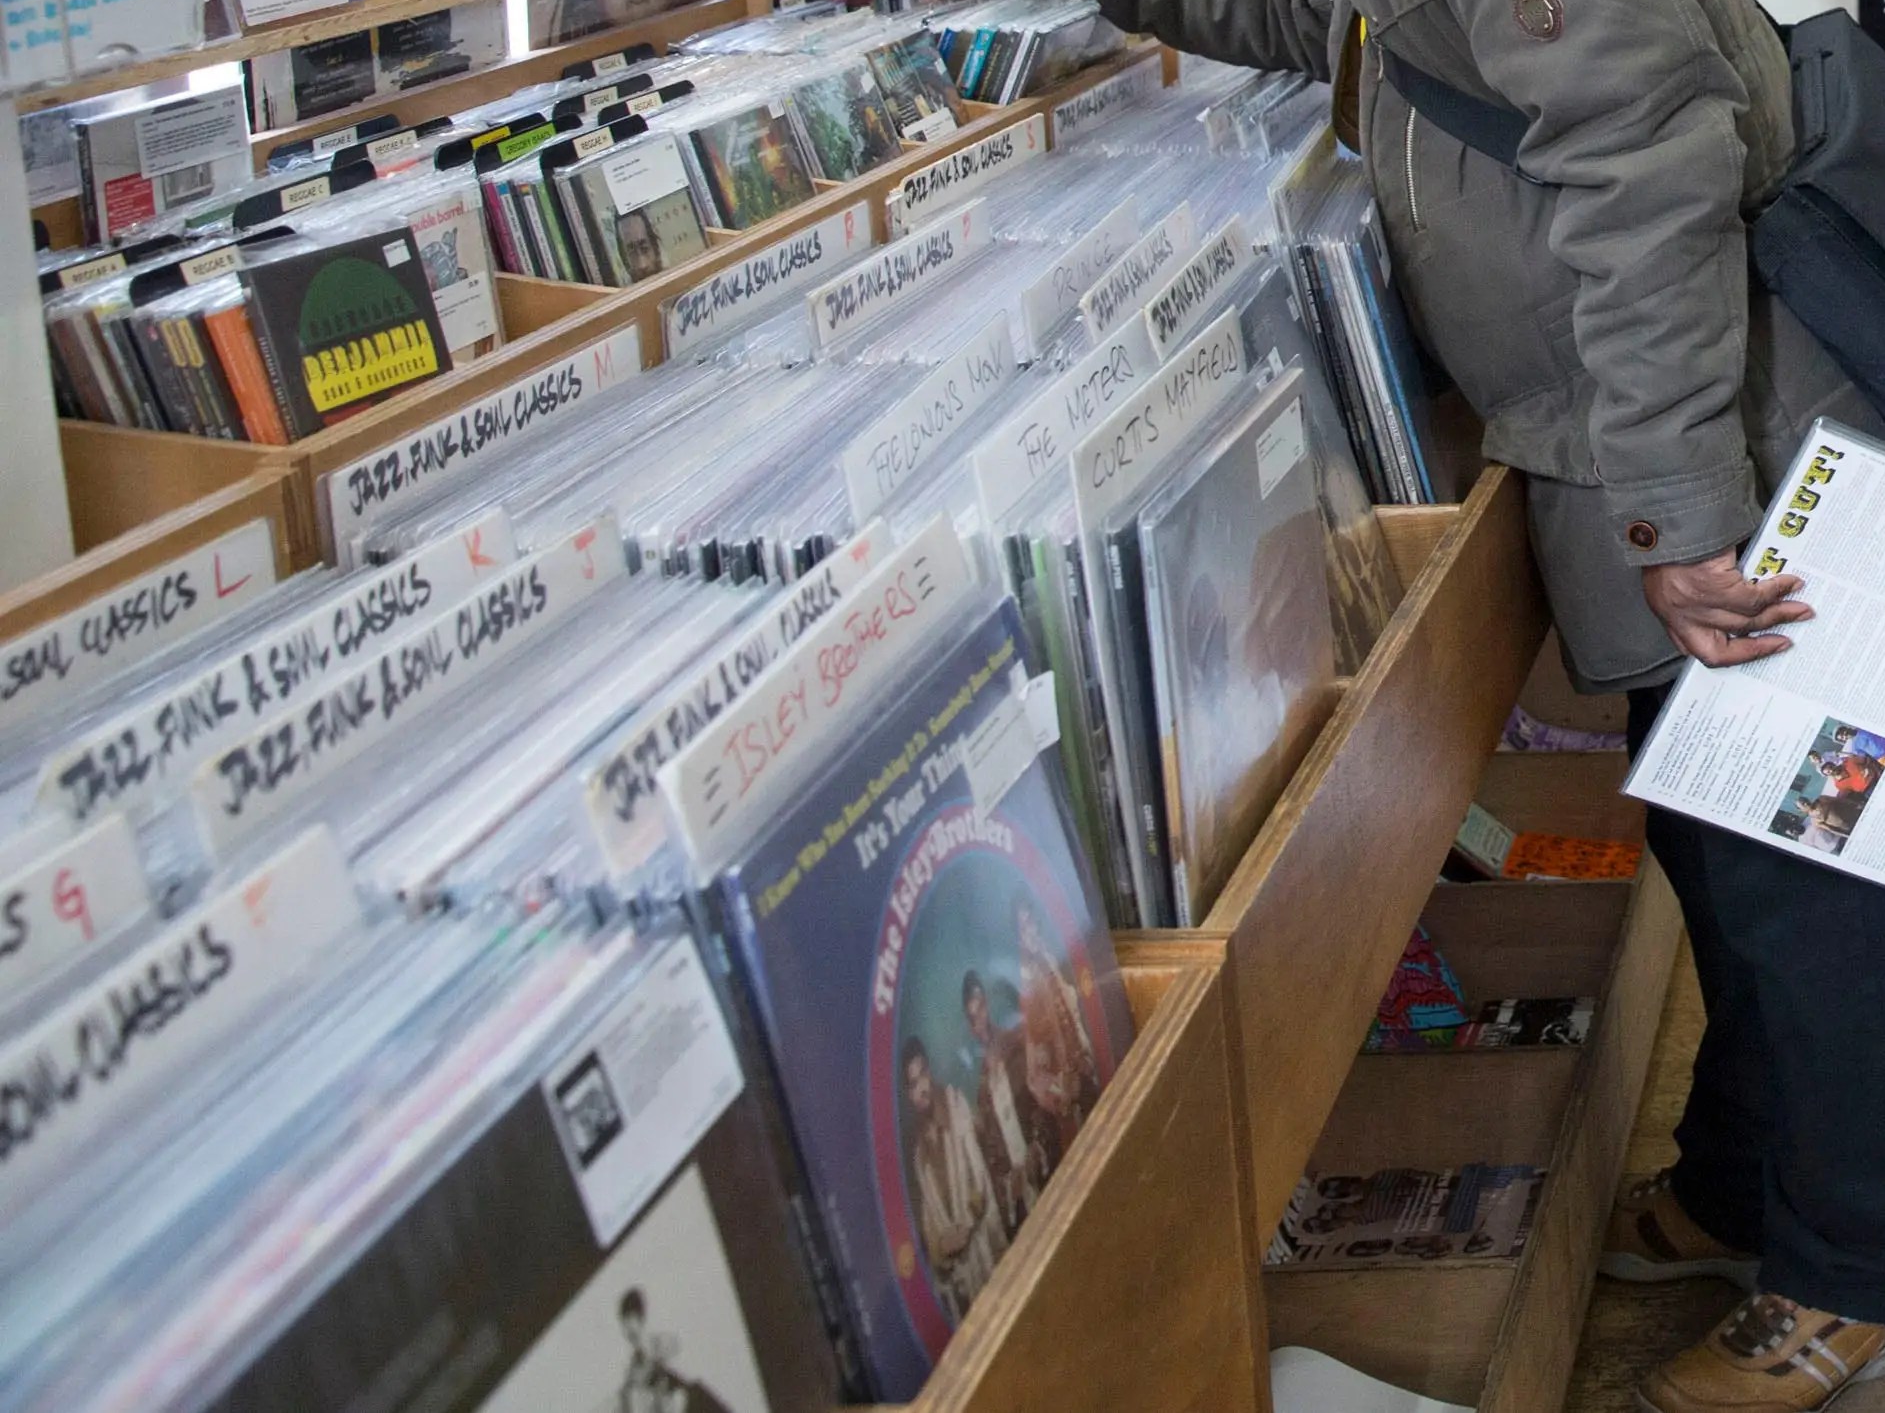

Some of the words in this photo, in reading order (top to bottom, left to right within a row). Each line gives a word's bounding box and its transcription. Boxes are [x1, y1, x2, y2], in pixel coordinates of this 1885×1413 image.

[288, 187, 317, 205] REGGAE
[1052, 232, 1117, 302] PRINCE
[474, 402, 516, 451] SOUL
[514, 363, 584, 432] CLASSICS
[594, 342, 616, 380] M
[1016, 421, 1057, 476] THE
[1065, 342, 1136, 430] METERS
[1090, 404, 1161, 490] CURTIS
[1163, 330, 1239, 419] MAYFIELD
[866, 381, 965, 498] THELONIOUS
[1777, 443, 1847, 538] CUT!
[6, 638, 74, 696] SOUL
[80, 571, 199, 655] CLASSICS
[212, 550, 252, 598] L
[331, 563, 434, 657] CLASSICS
[400, 630, 457, 698] SOUL
[455, 563, 549, 660] CLASSICS
[721, 680, 816, 797] ISLEY
[814, 570, 917, 709] BROTHERS
[76, 923, 234, 1082] CLASSICS
